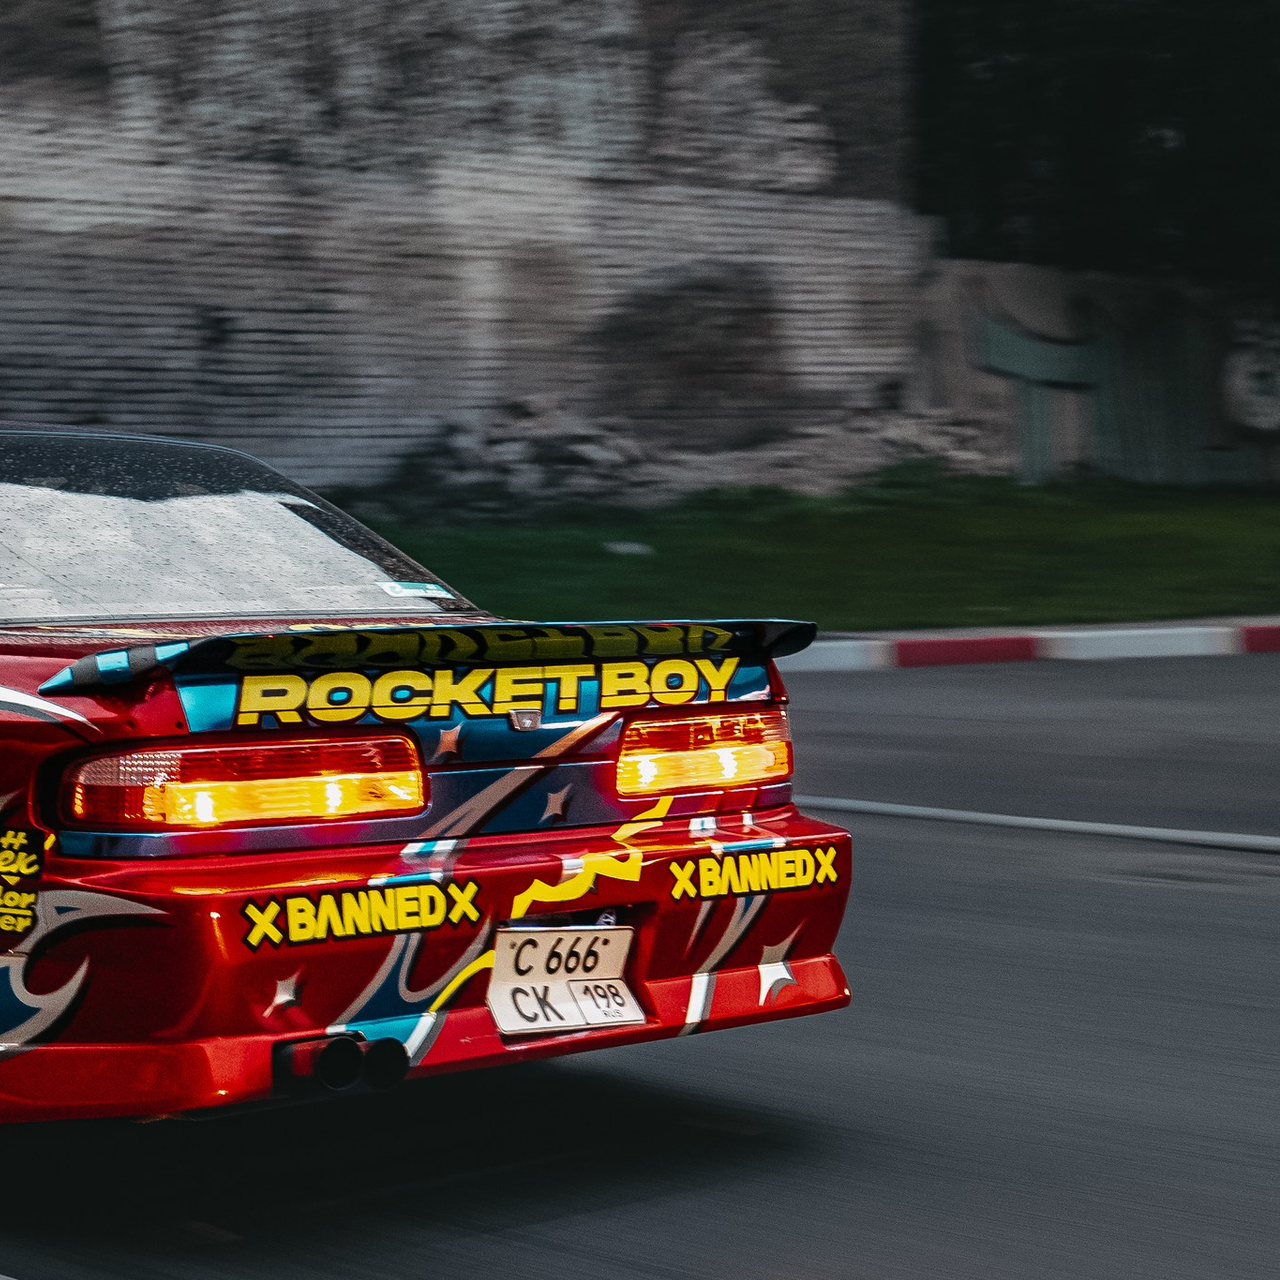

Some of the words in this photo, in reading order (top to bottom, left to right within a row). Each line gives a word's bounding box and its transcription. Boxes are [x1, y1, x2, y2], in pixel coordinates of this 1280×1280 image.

[600, 657, 740, 709] BOY
[545, 936, 600, 975] 666
[511, 985, 565, 1023] CK
[583, 984, 626, 1010] 198
